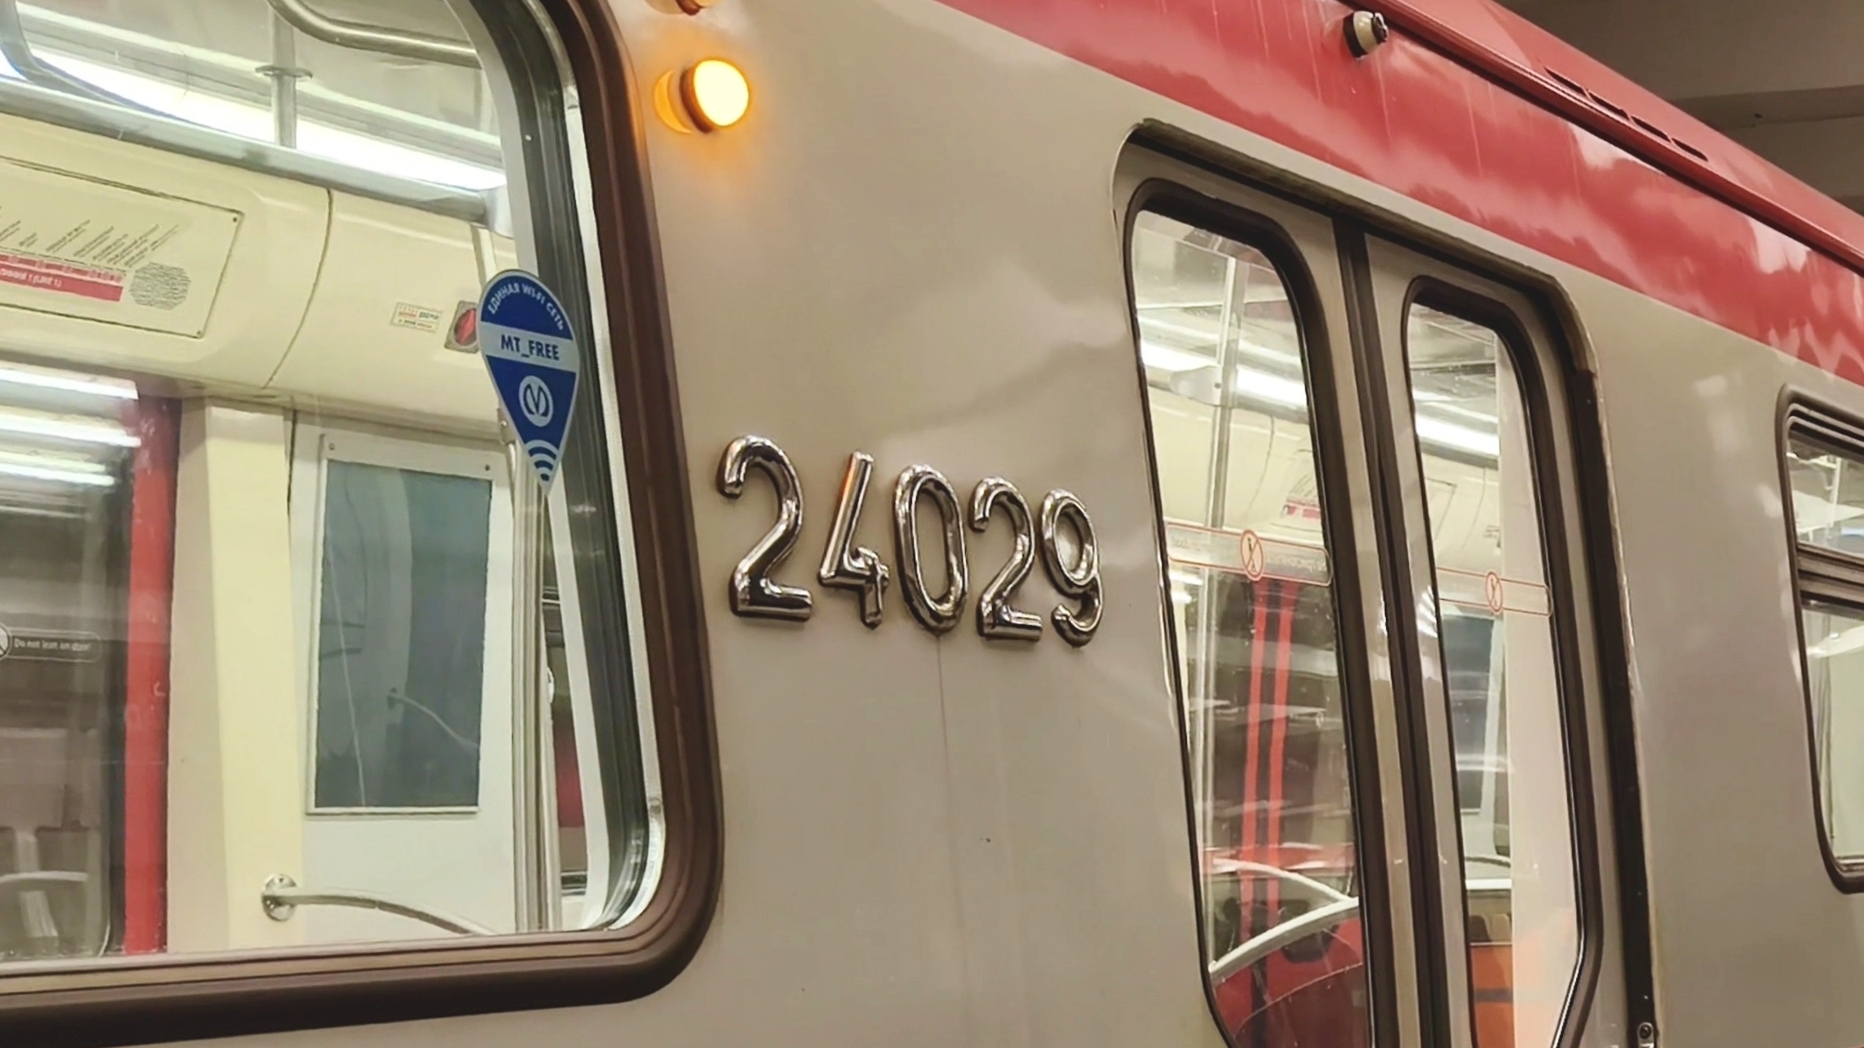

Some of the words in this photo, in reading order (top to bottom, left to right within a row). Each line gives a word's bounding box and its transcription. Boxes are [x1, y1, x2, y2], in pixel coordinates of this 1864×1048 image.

[487, 282, 520, 315] ЕДИНАЯ
[546, 302, 564, 331] СЕТЬ
[501, 334, 560, 361] MT_FREE
[716, 433, 1105, 649] 24029
